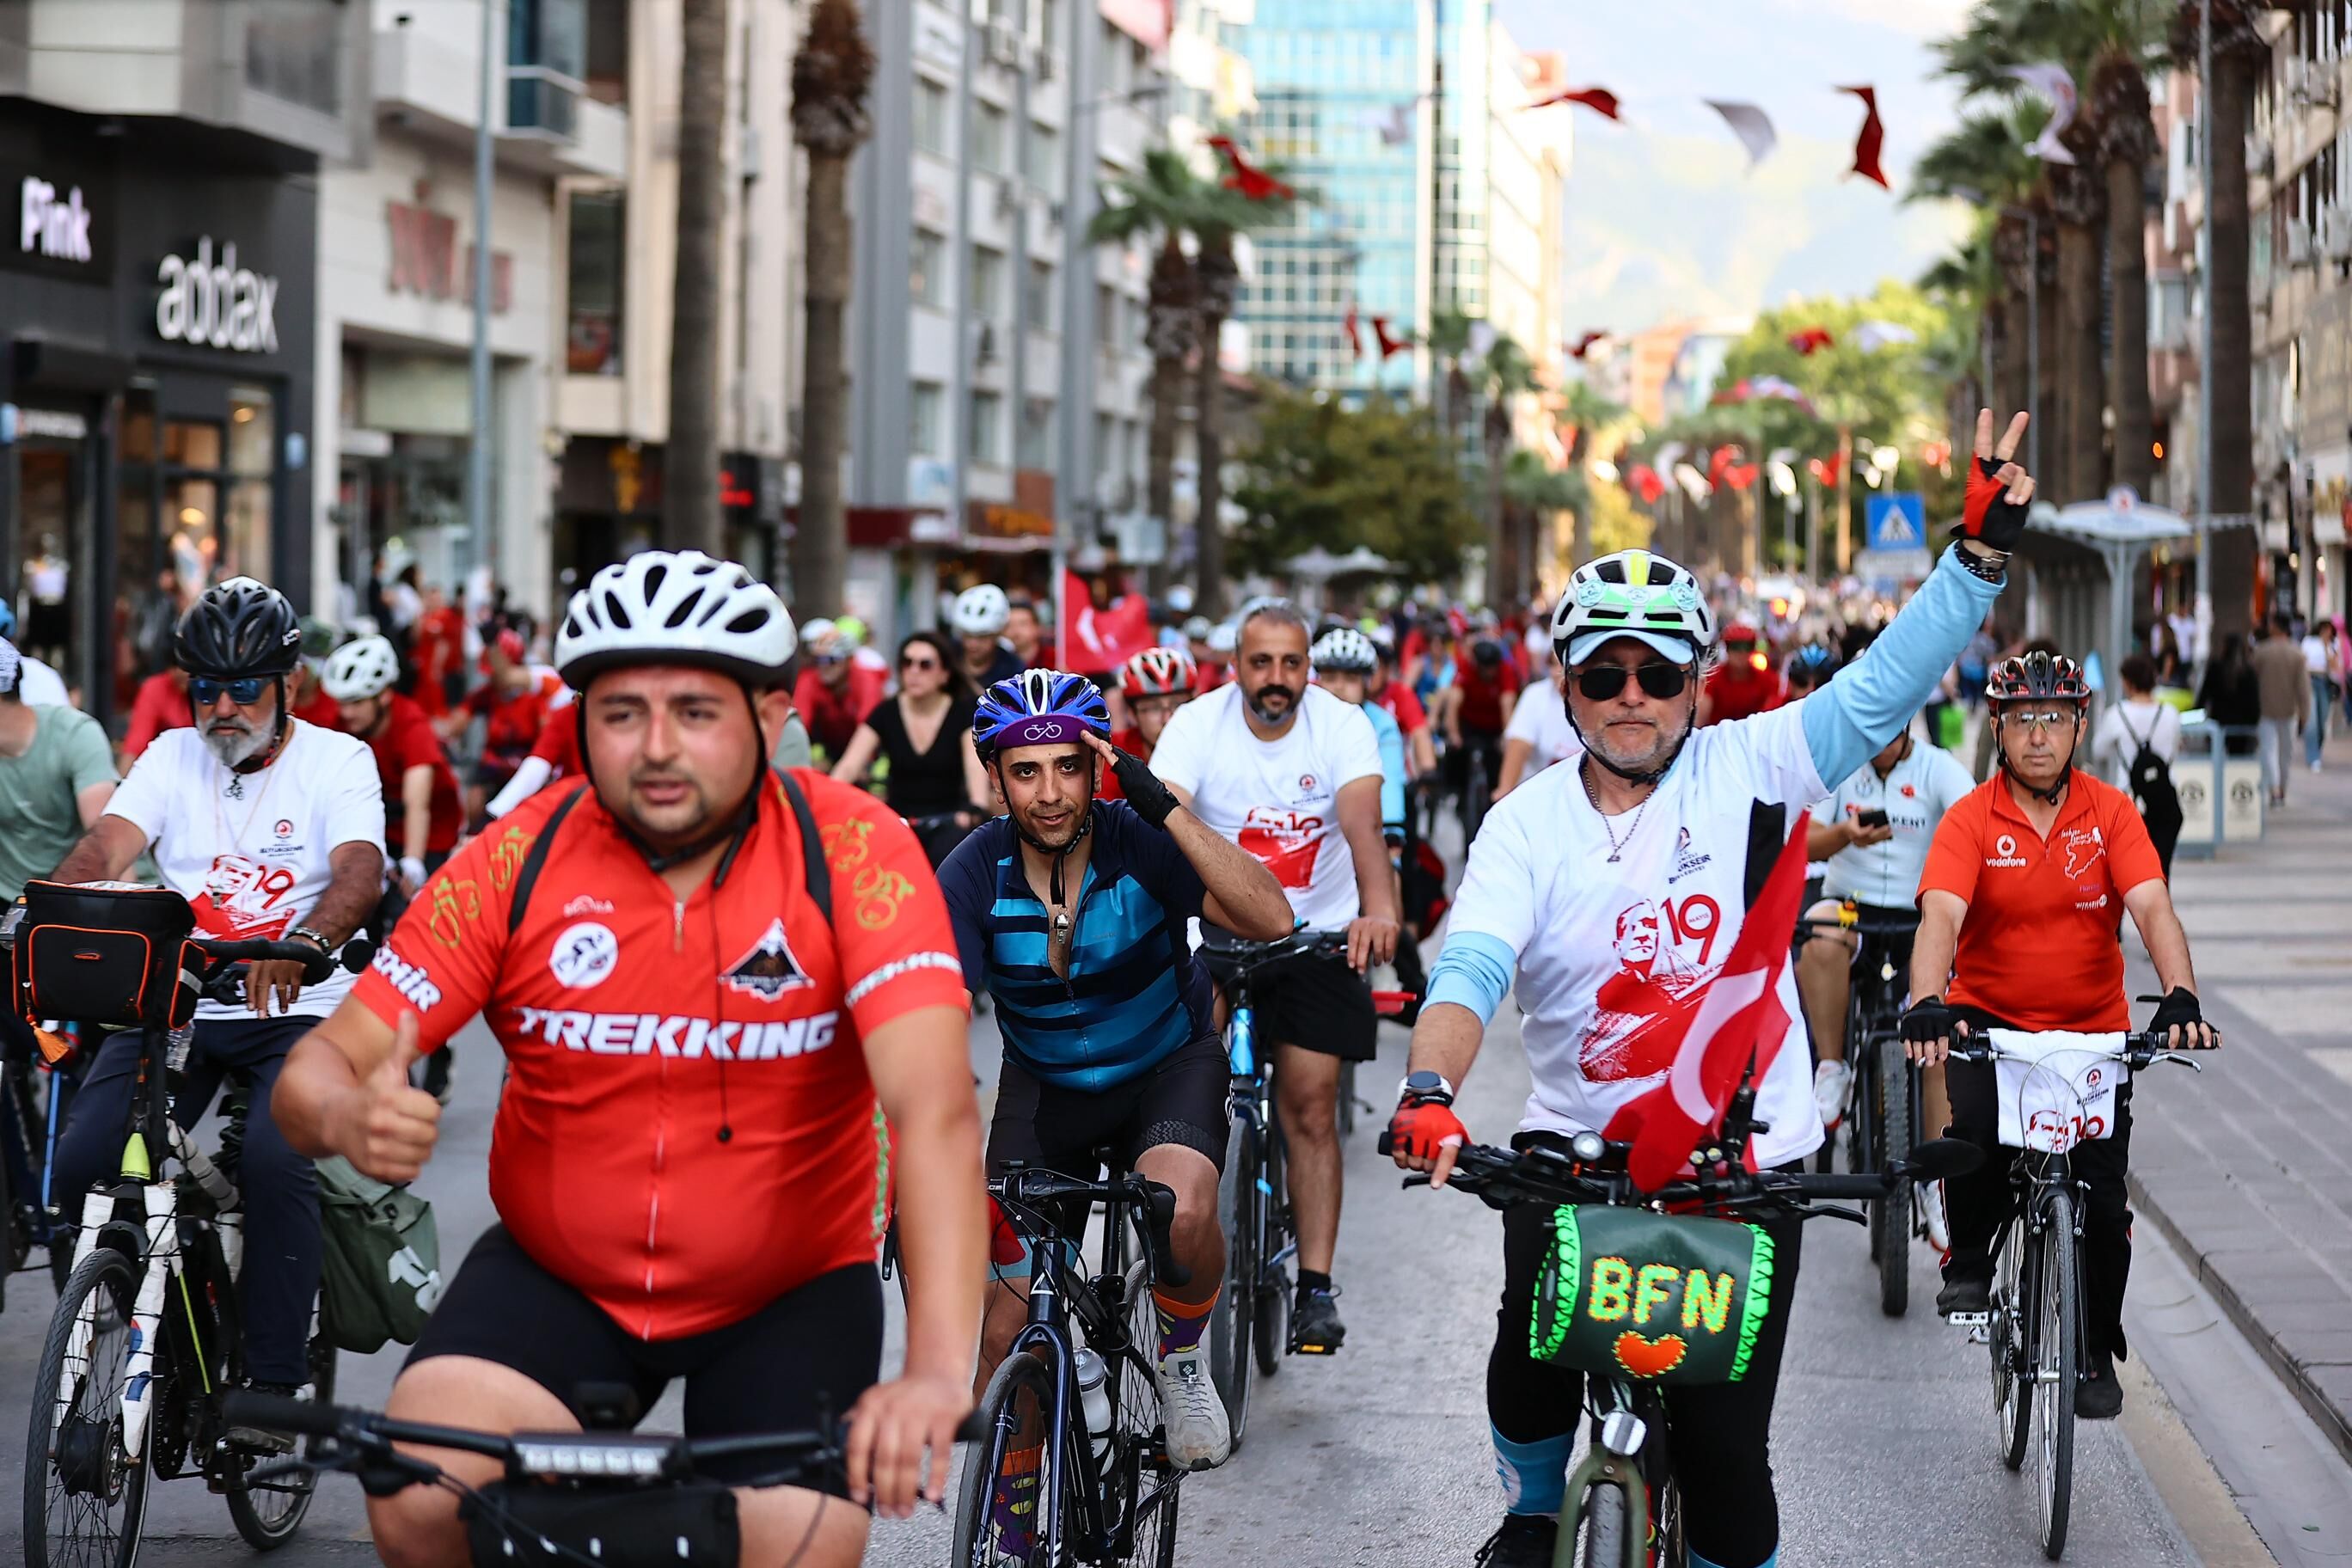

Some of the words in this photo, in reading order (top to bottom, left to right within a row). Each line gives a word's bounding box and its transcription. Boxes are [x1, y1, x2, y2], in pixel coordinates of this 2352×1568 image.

[156, 234, 279, 354] addax
[252, 864, 296, 910] 19
[1986, 856, 2027, 867] vodafone
[1660, 894, 1721, 966] 19
[511, 1005, 841, 1061] TREKKING
[1587, 1255, 1736, 1335] BFN
